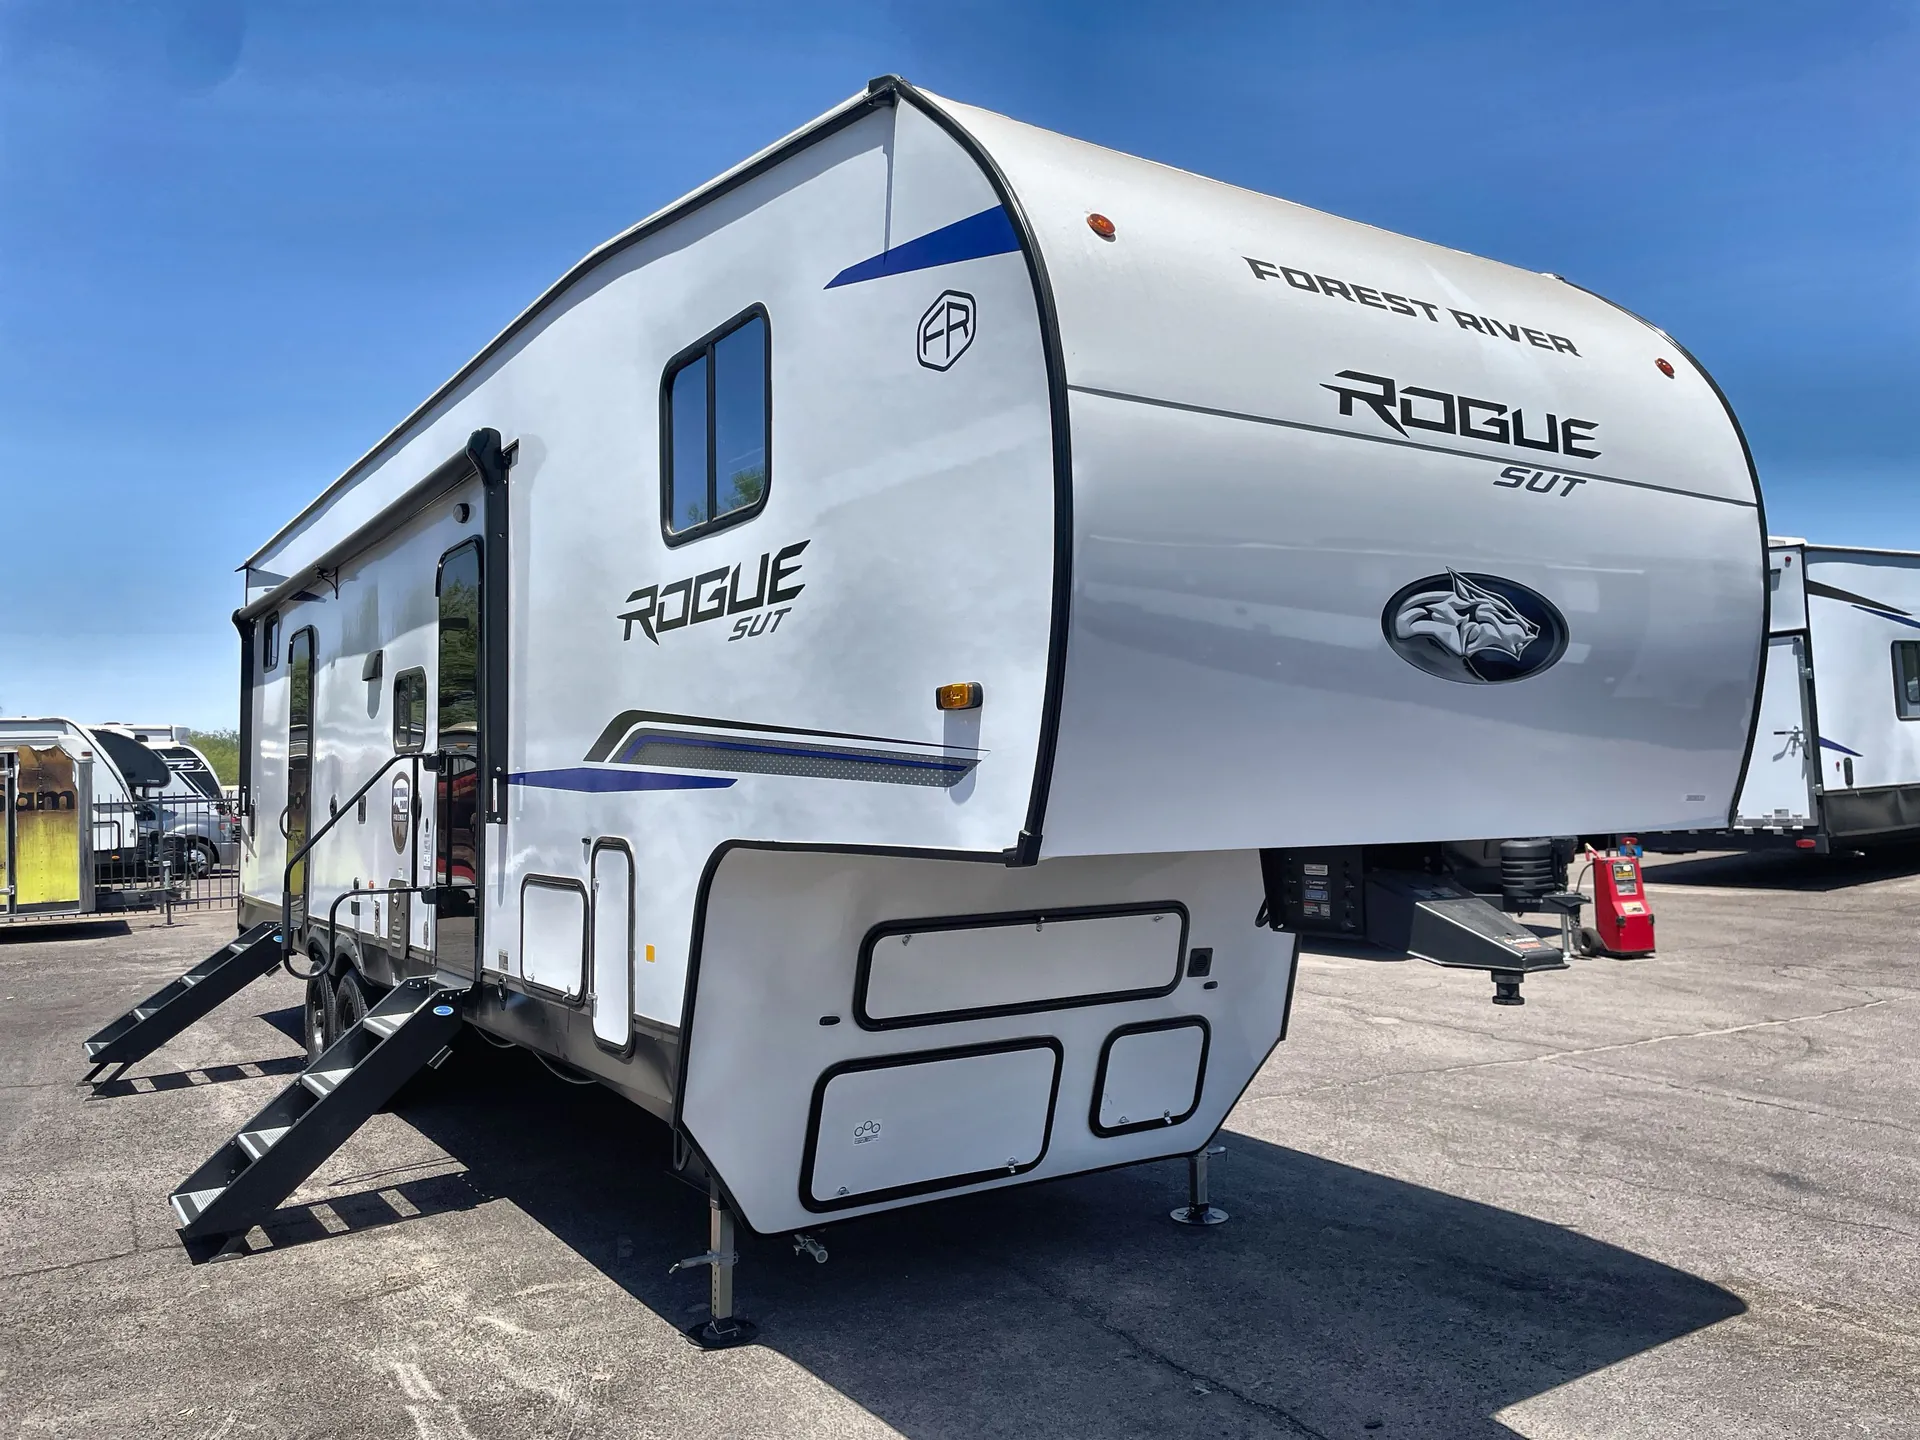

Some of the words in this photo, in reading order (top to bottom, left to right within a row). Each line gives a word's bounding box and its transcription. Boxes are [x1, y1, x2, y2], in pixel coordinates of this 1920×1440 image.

[1241, 255, 1440, 323] FOREST
[1446, 307, 1583, 358] RIVER
[1318, 369, 1602, 460] ROGUE
[1492, 465, 1588, 498] SUT
[616, 538, 811, 647] ROGUE
[727, 606, 793, 642] SUT
